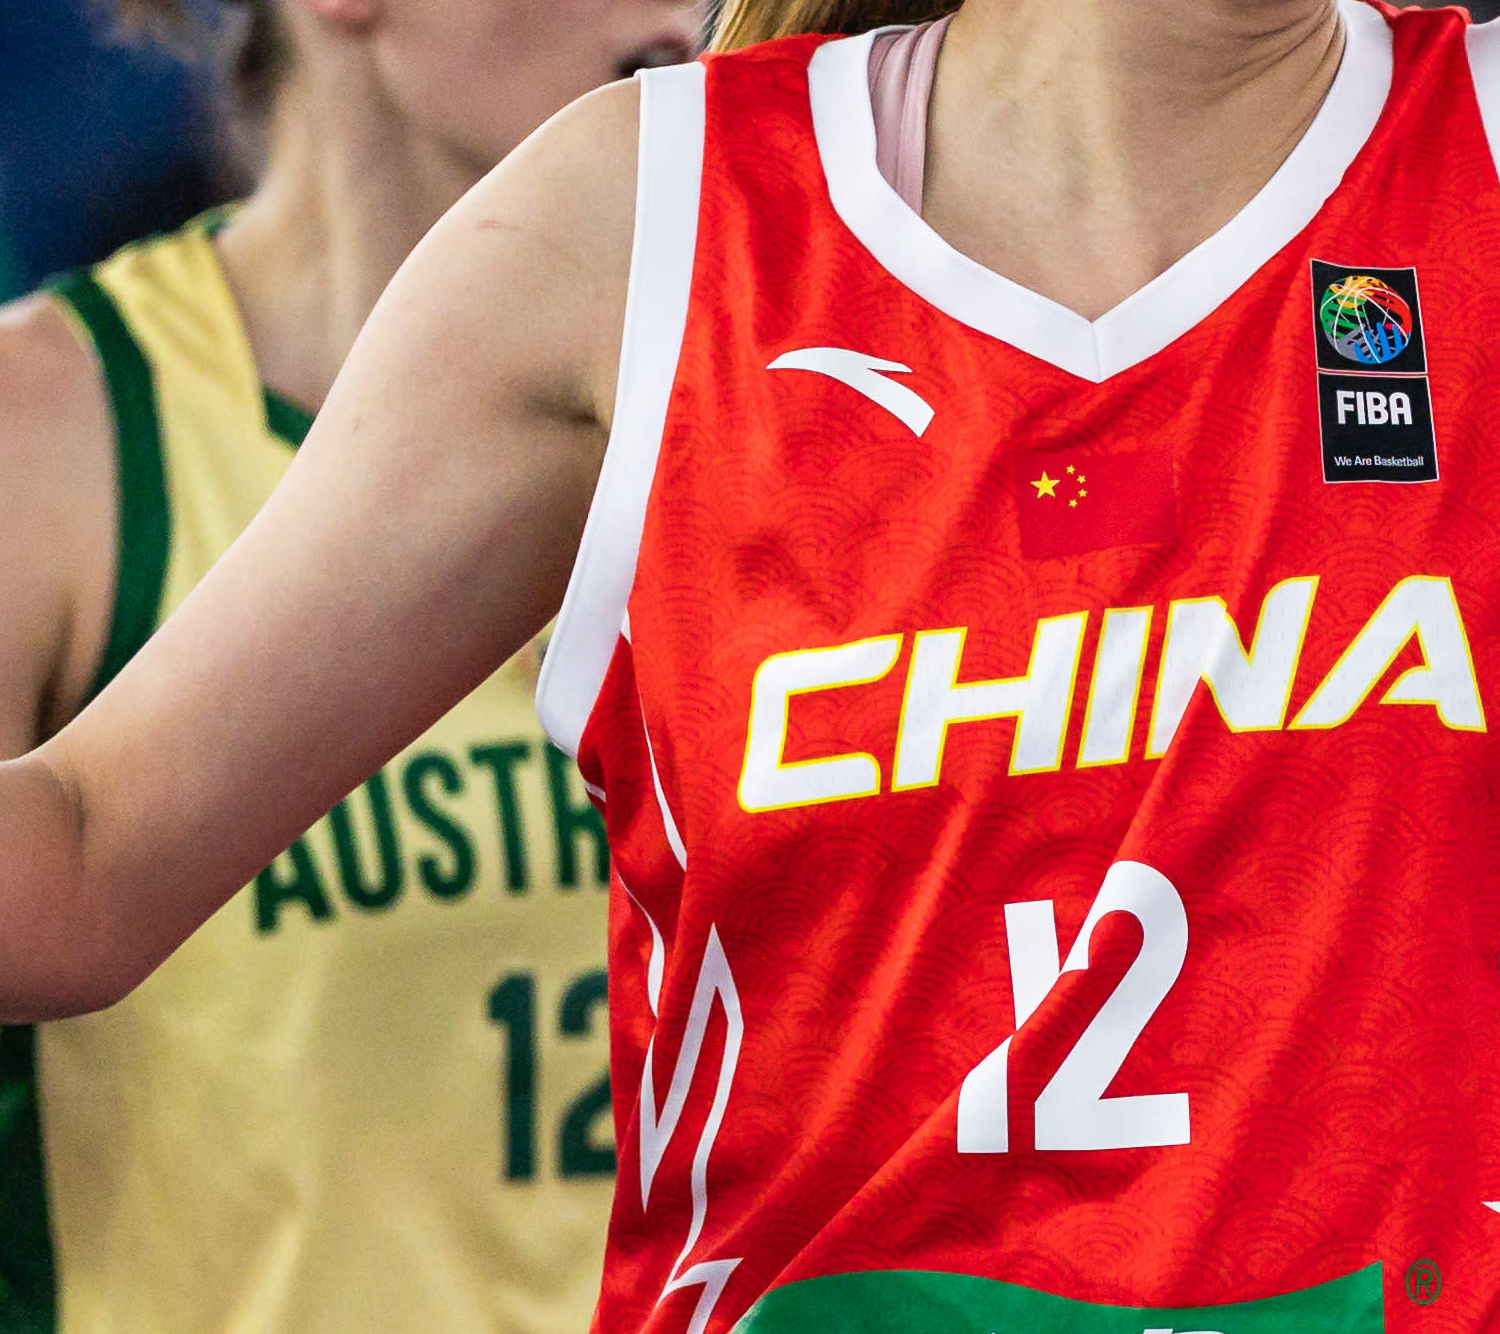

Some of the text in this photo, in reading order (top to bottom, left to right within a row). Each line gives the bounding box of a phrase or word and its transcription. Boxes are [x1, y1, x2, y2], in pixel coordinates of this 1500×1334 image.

[1334, 455, 1424, 466] We Are Basketball
[1337, 390, 1412, 425] FIBA
[737, 574, 1485, 813] CHINA
[487, 971, 616, 1183] 12
[956, 860, 1191, 1153] 12
